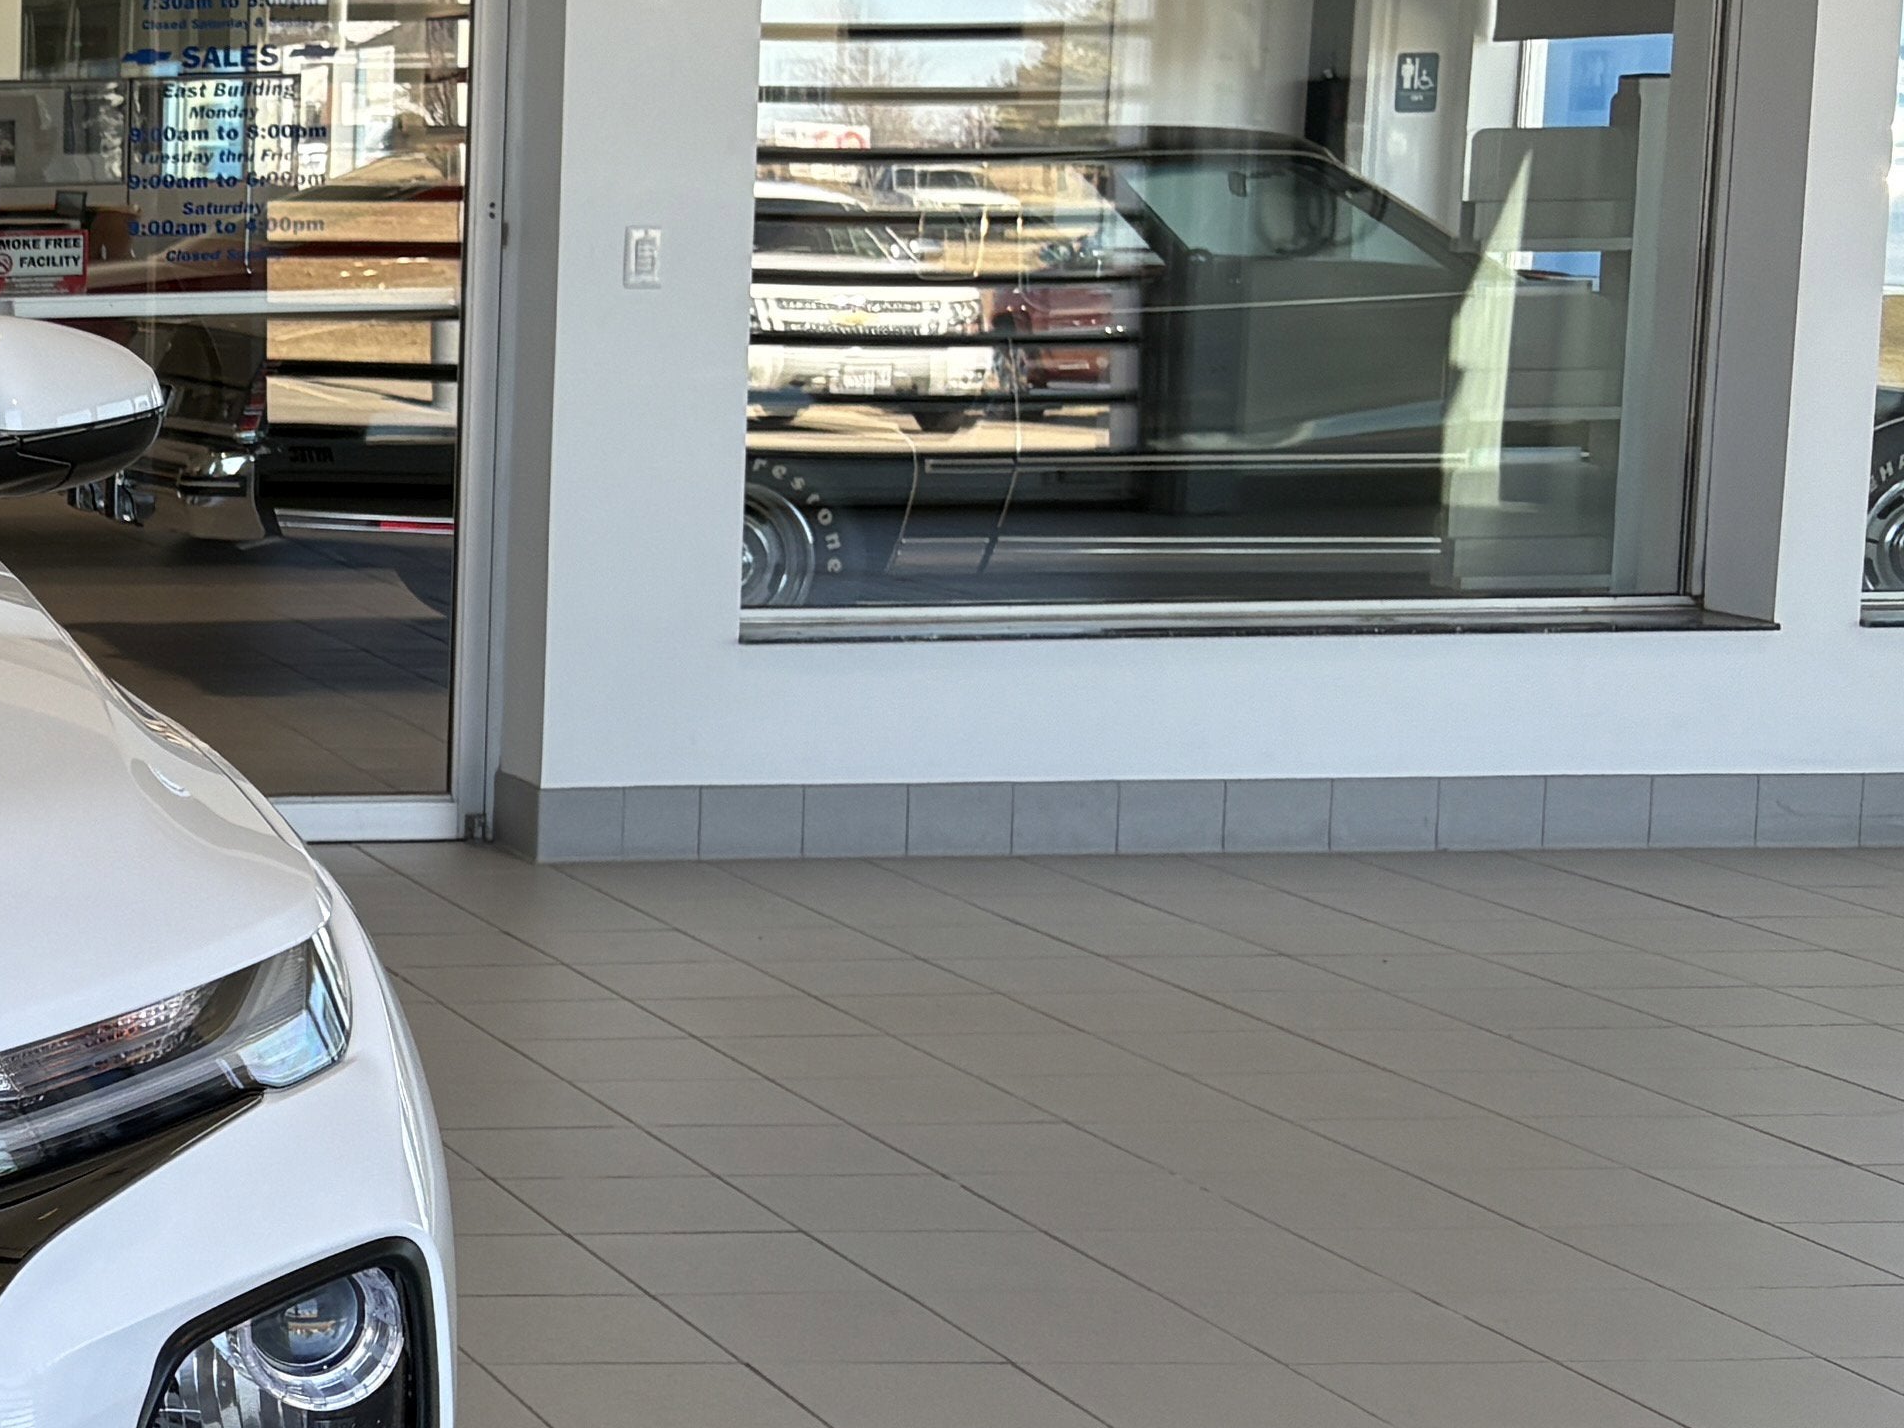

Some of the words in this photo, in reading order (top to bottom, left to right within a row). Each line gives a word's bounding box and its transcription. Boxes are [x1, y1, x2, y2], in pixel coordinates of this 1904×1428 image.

[181, 44, 280, 69] SALES
[163, 83, 207, 98] East
[213, 80, 297, 99] Building
[189, 105, 259, 120] Monday
[217, 125, 239, 141] to
[219, 148, 254, 163] thru
[217, 172, 238, 187] to
[182, 200, 265, 217] Saturday
[216, 219, 236, 234] to
[45, 237, 82, 249] FREE
[19, 254, 81, 268] FACILITY
[166, 249, 222, 262] Closed
